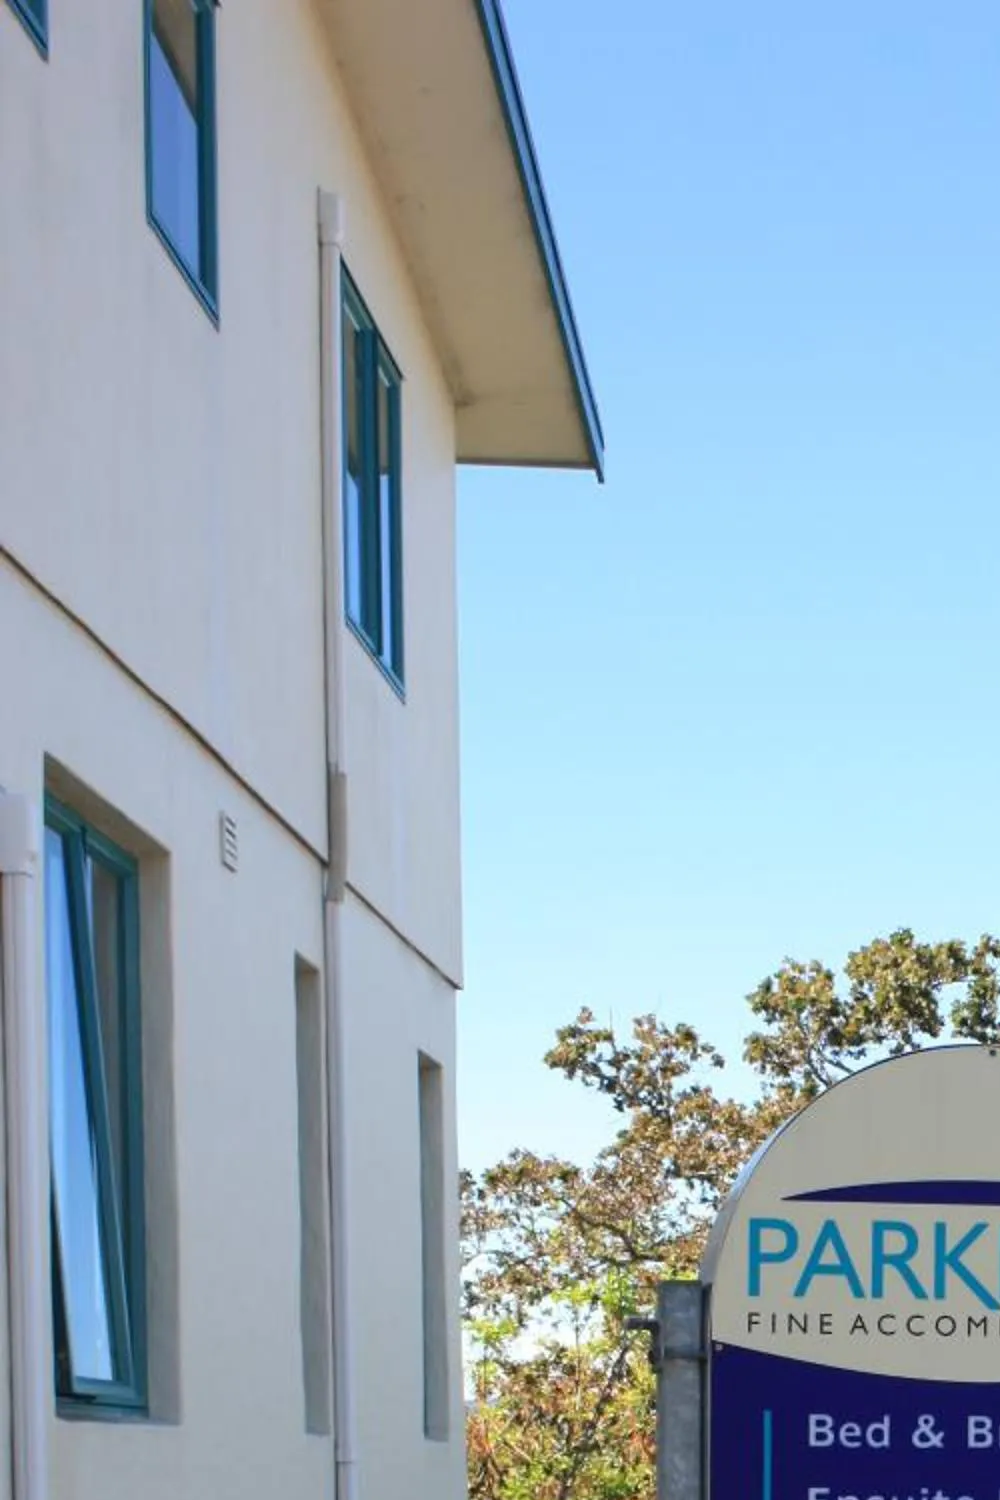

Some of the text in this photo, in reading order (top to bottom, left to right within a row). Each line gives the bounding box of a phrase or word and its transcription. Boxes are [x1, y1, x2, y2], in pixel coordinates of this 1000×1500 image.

[747, 1313, 834, 1334] FINE
[807, 1414, 890, 1448] Bed
[911, 1415, 945, 1449] &
